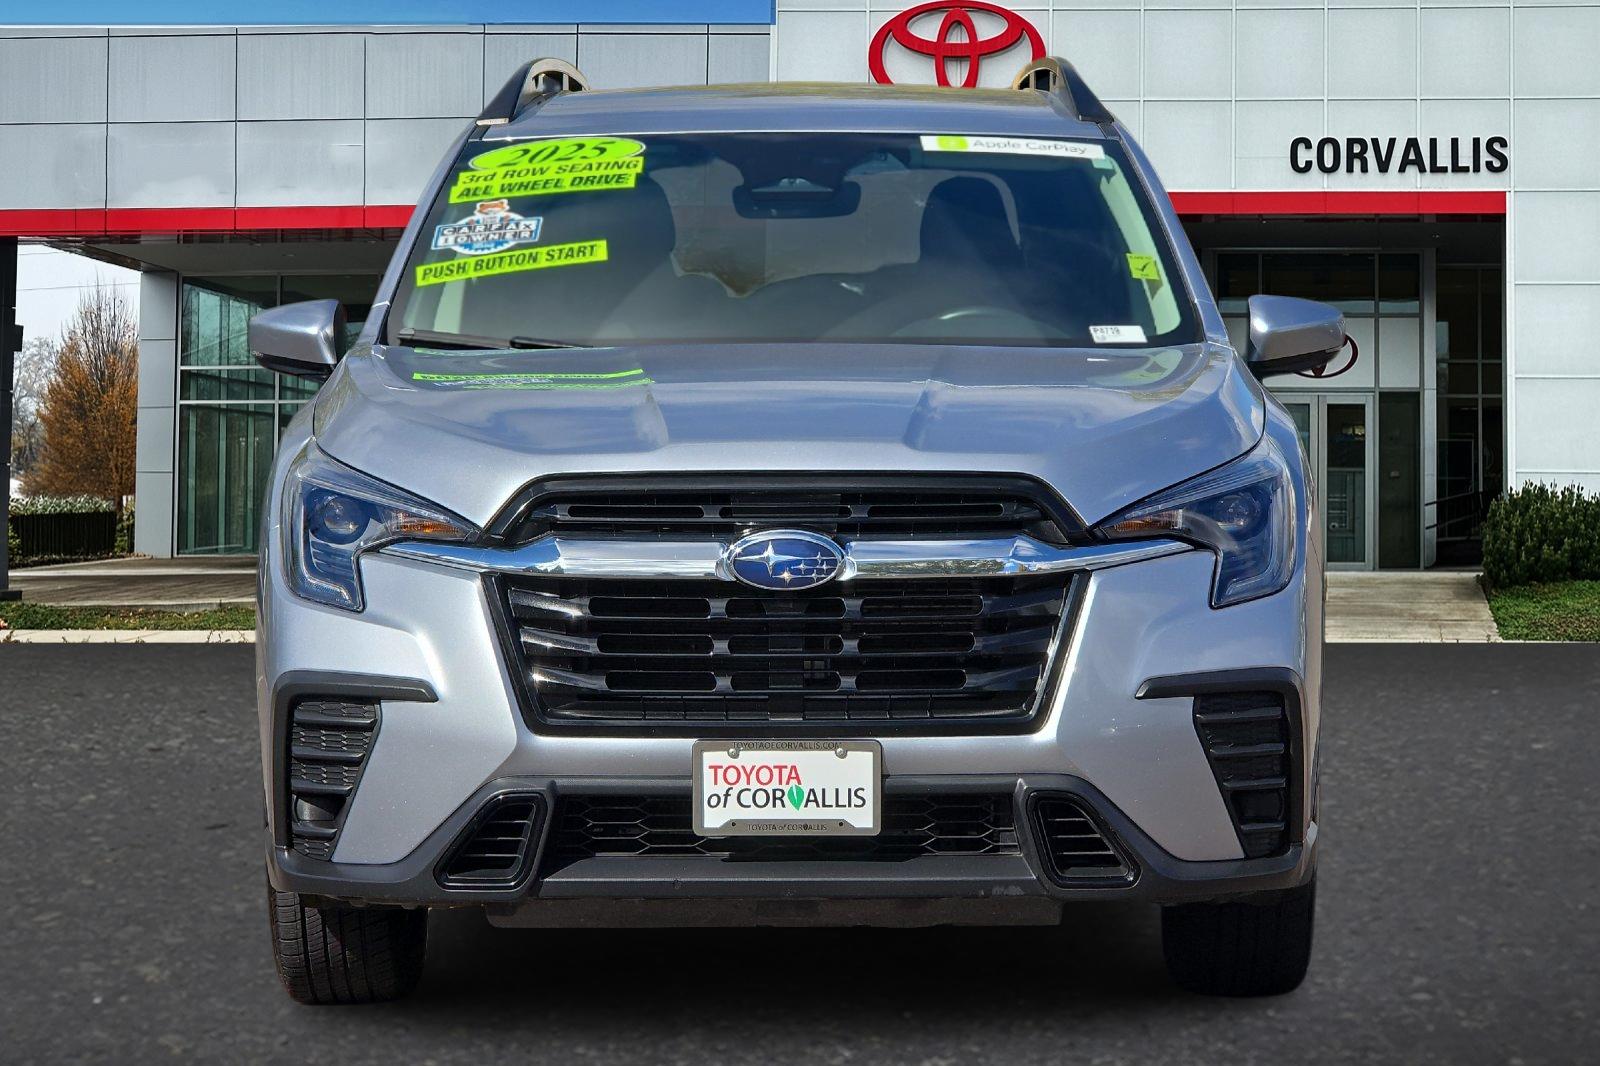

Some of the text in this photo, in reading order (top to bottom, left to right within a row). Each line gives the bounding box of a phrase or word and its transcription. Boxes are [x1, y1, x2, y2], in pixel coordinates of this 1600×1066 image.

[499, 141, 616, 168] 2025
[973, 139, 1088, 155] Apple CarPlay
[1289, 136, 1509, 174] CORVALLIS
[463, 159, 640, 184] 3rd ROW SEATING
[456, 173, 629, 199] ALL WHEEL DRIVE
[442, 222, 534, 236] CARFAX
[457, 231, 532, 244] OWNER
[421, 243, 597, 281] PUSH BUTTON START
[708, 764, 802, 786] TOYOTA
[707, 787, 733, 809] of
[748, 823, 777, 832] TOYOTA
